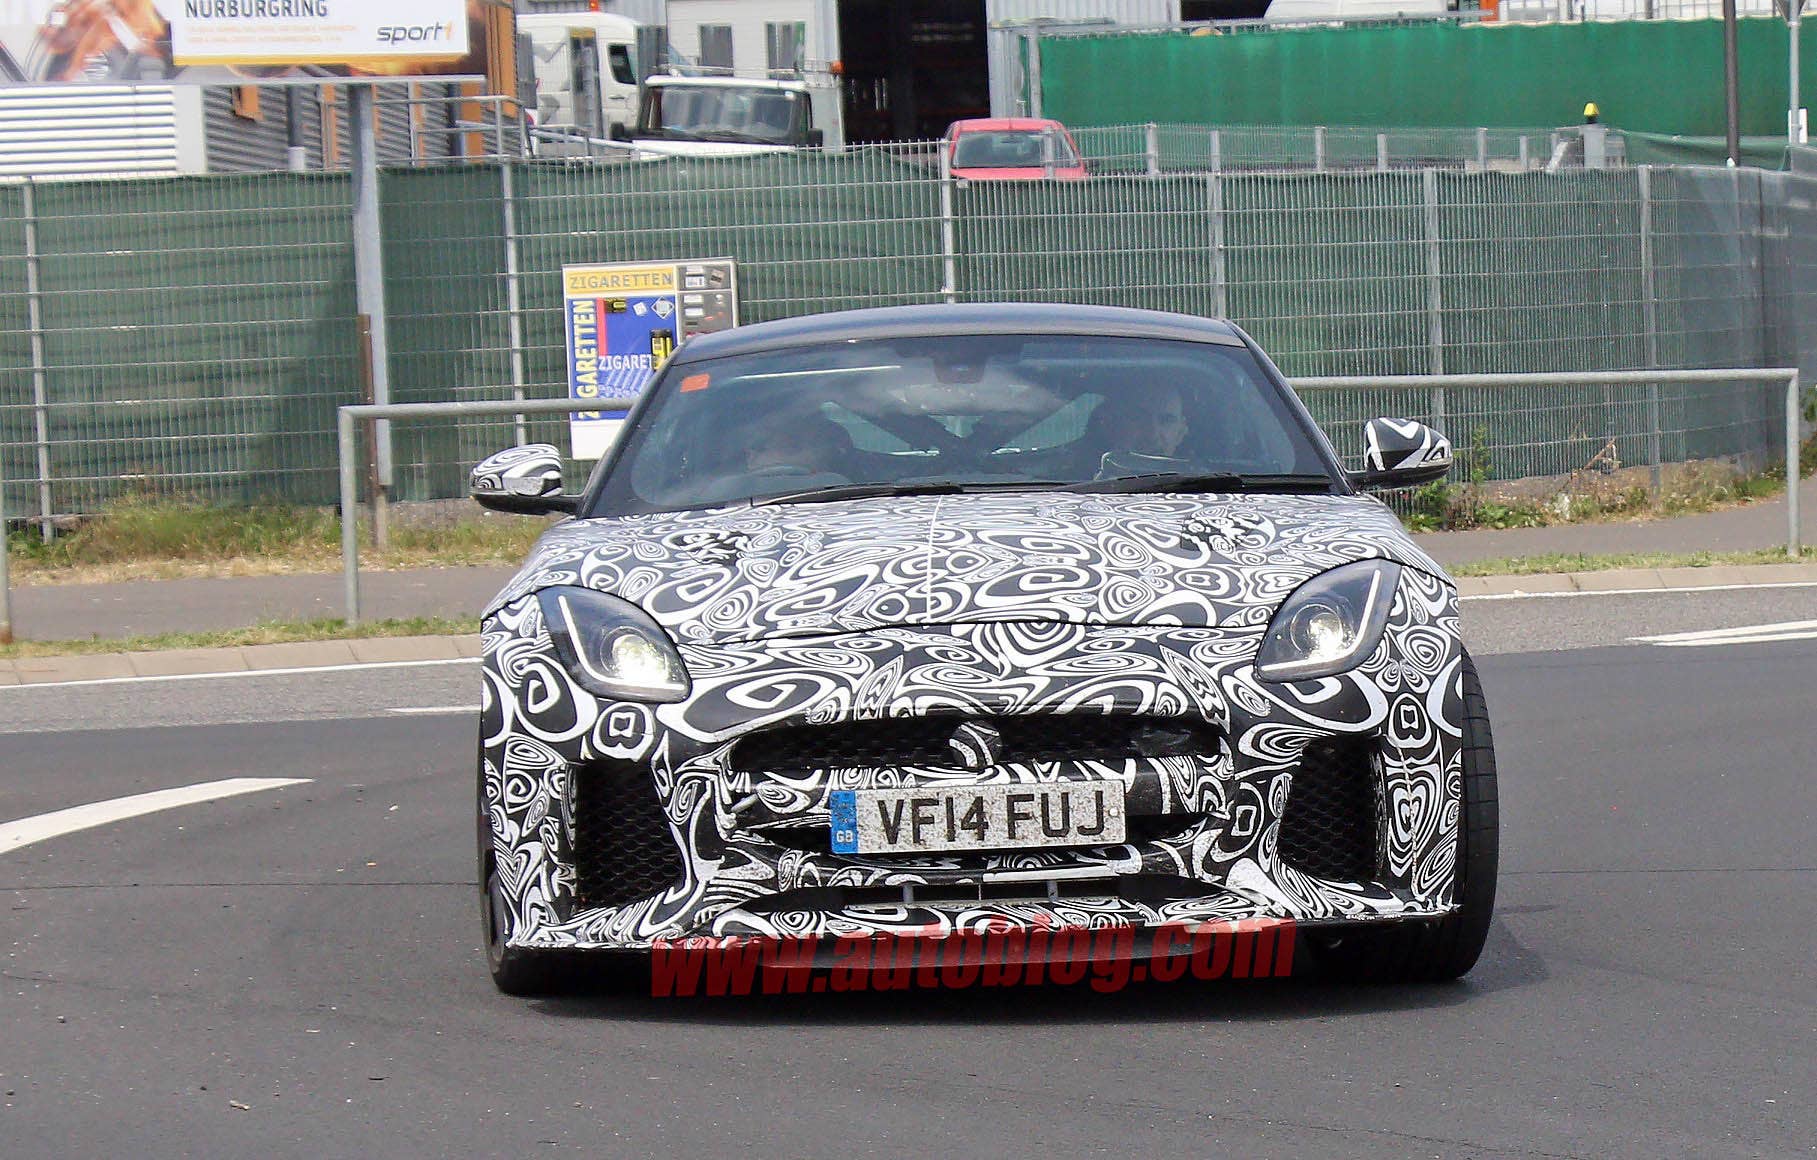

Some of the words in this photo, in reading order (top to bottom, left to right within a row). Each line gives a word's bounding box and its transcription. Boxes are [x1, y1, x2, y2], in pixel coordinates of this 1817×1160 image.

[569, 272, 673, 289] ZIGARETTEN
[573, 300, 600, 419] ZGARETTEN
[598, 354, 653, 371] ZIGARET
[877, 796, 989, 845] VF14
[1006, 790, 1105, 840] FUJ
[836, 831, 854, 843] GB
